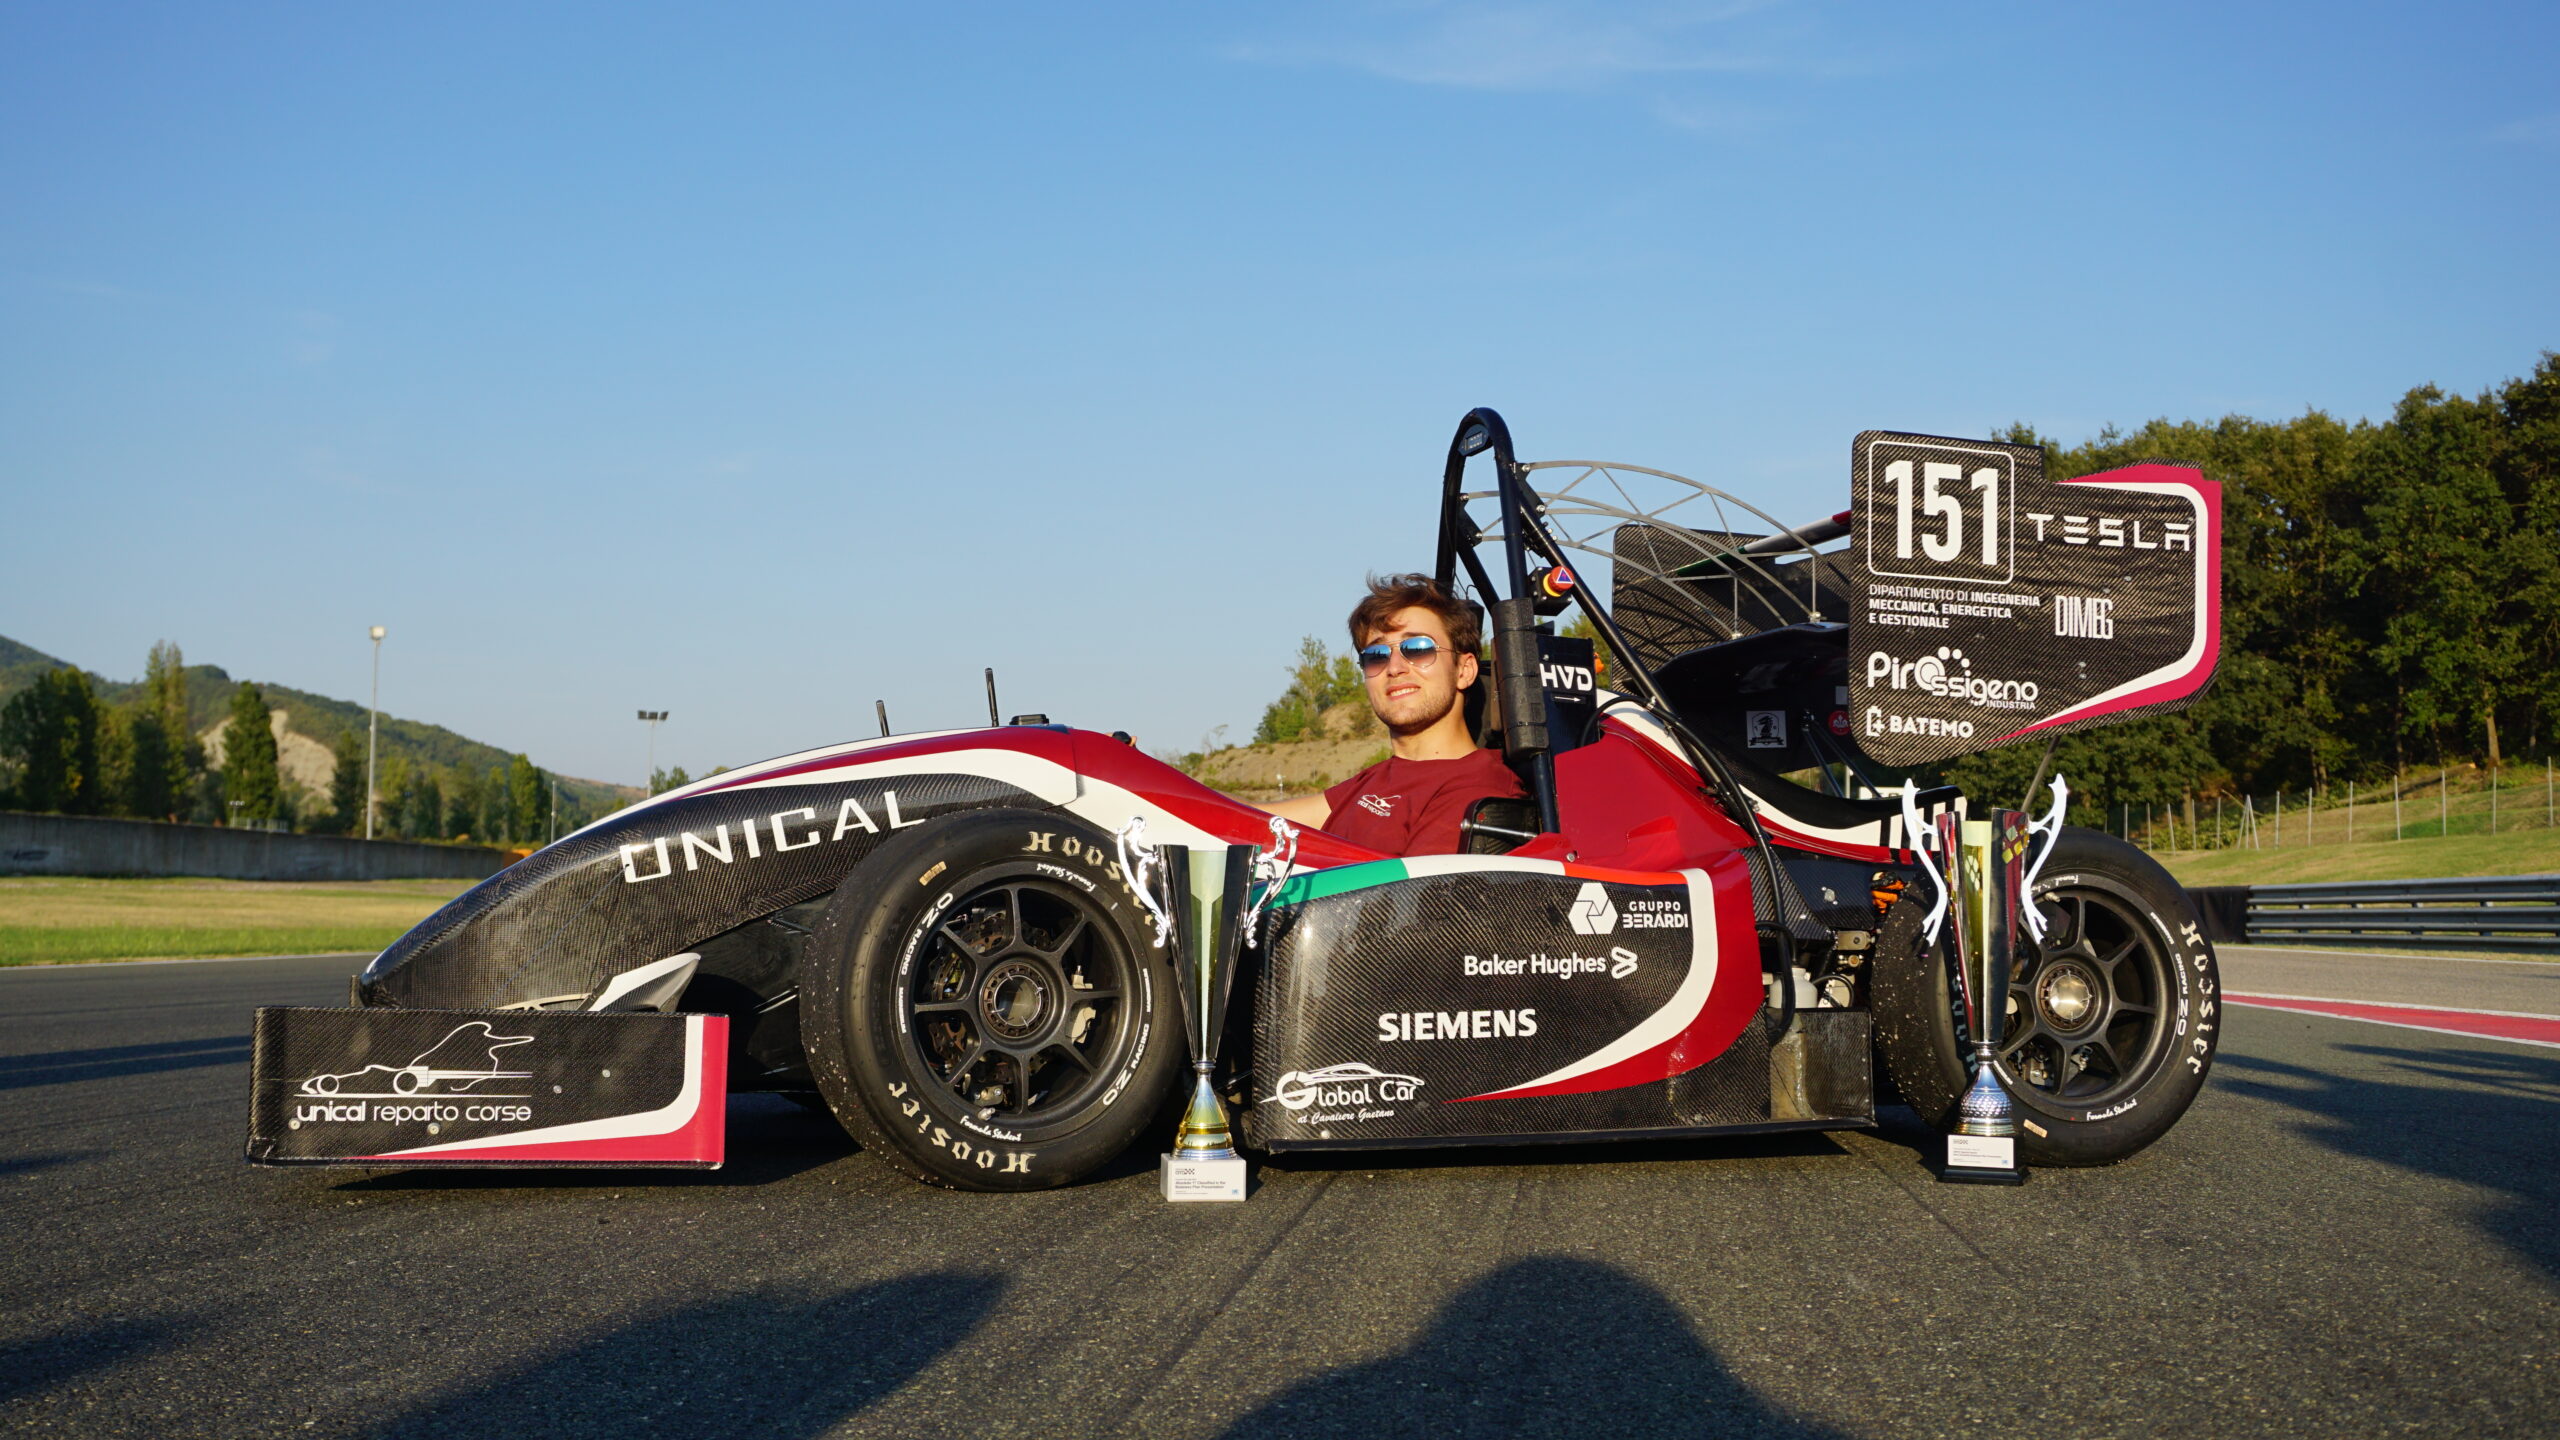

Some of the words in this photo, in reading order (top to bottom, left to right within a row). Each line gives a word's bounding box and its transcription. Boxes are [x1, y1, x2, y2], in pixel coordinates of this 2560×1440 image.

[1885, 460, 1998, 566] 151
[2026, 512, 2190, 552] TESLA
[1869, 584, 1954, 600] DIPARTIMENTO
[1956, 590, 1969, 601] DI
[1970, 591, 2041, 607] INGEGNERIA
[1869, 598, 1939, 616] MECCANICA,
[1942, 603, 2012, 619] ENERGETICA
[1869, 612, 1877, 624] E
[1879, 613, 1950, 629] GESTIONALE
[1539, 662, 1593, 692] HVD
[1986, 700, 2036, 711] INDUSTRIA
[1889, 714, 1975, 739] BATEMO
[619, 790, 926, 884] UNICAL
[1622, 912, 1689, 928] BERARDI
[1629, 901, 1681, 912] GRUPPO
[901, 928, 923, 976] RACING
[1464, 954, 1528, 976] Baker
[1531, 952, 1607, 980] Hughes
[2179, 919, 2215, 1075] Hoosier
[1378, 1008, 1538, 1042] SIEMENS
[1125, 1023, 1150, 1069] RACING
[1276, 1071, 1373, 1110] Global
[1380, 1080, 1417, 1101] Car
[297, 1100, 366, 1122] unical
[373, 1101, 459, 1126] reparto
[465, 1106, 532, 1122] corse
[888, 1081, 1037, 1174] Hoosier
